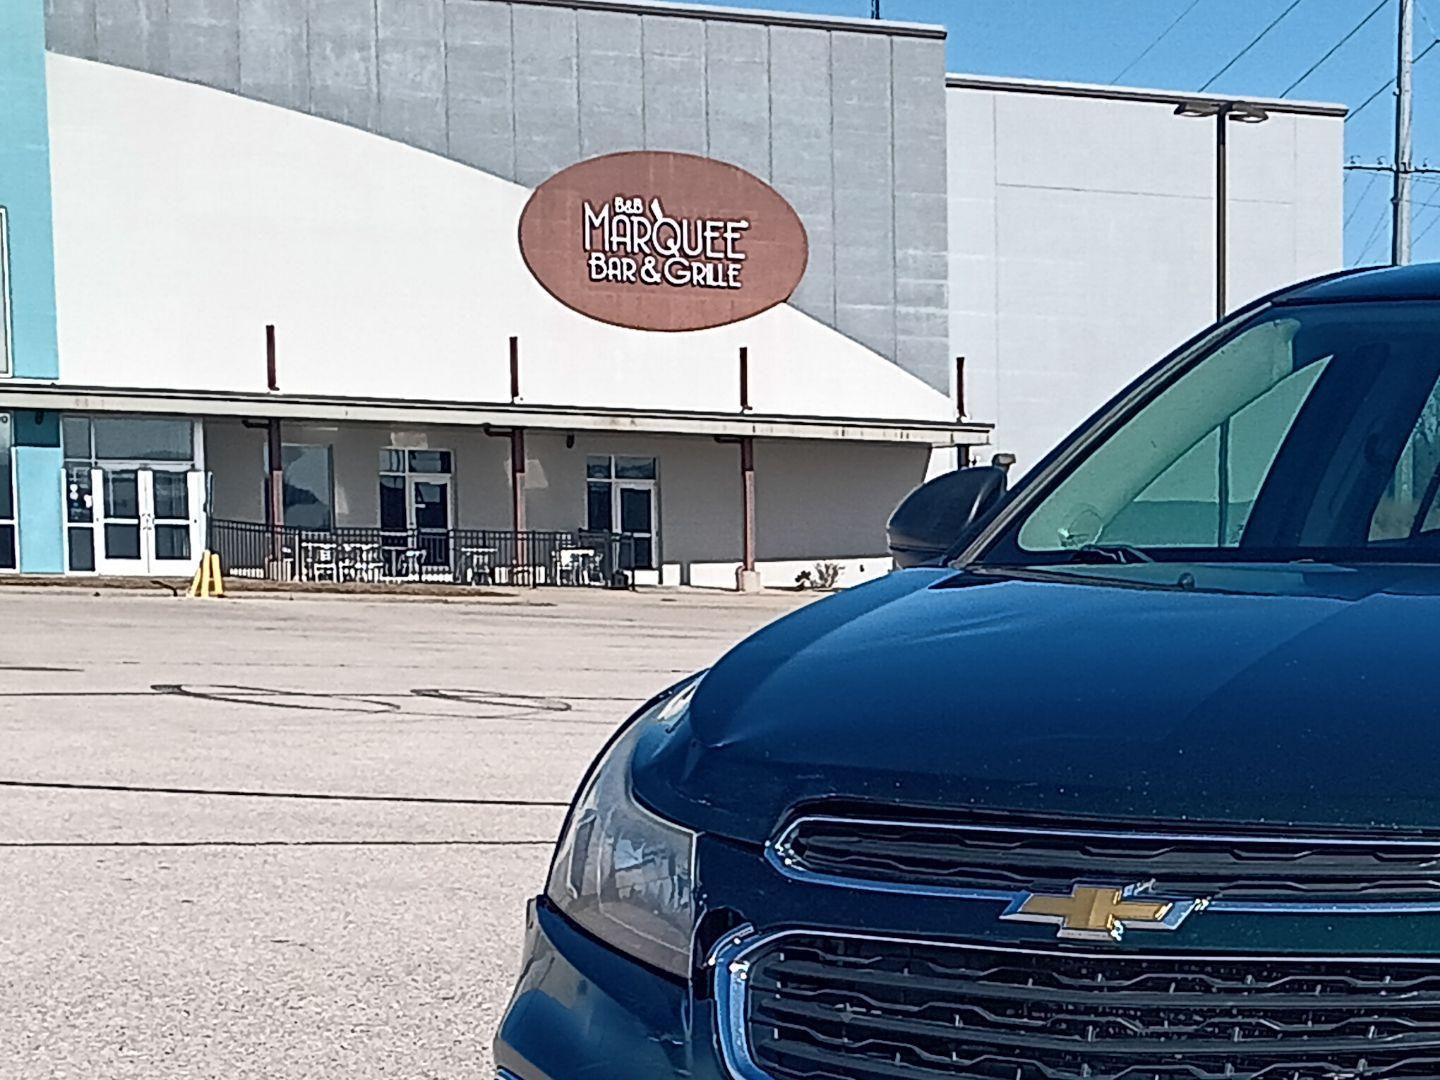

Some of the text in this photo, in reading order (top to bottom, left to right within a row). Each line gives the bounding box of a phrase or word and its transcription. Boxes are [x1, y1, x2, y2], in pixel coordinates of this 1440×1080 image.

[614, 197, 643, 214] B&B
[583, 198, 749, 260] MARQUEE
[588, 253, 742, 288] BAR & GRILLE
